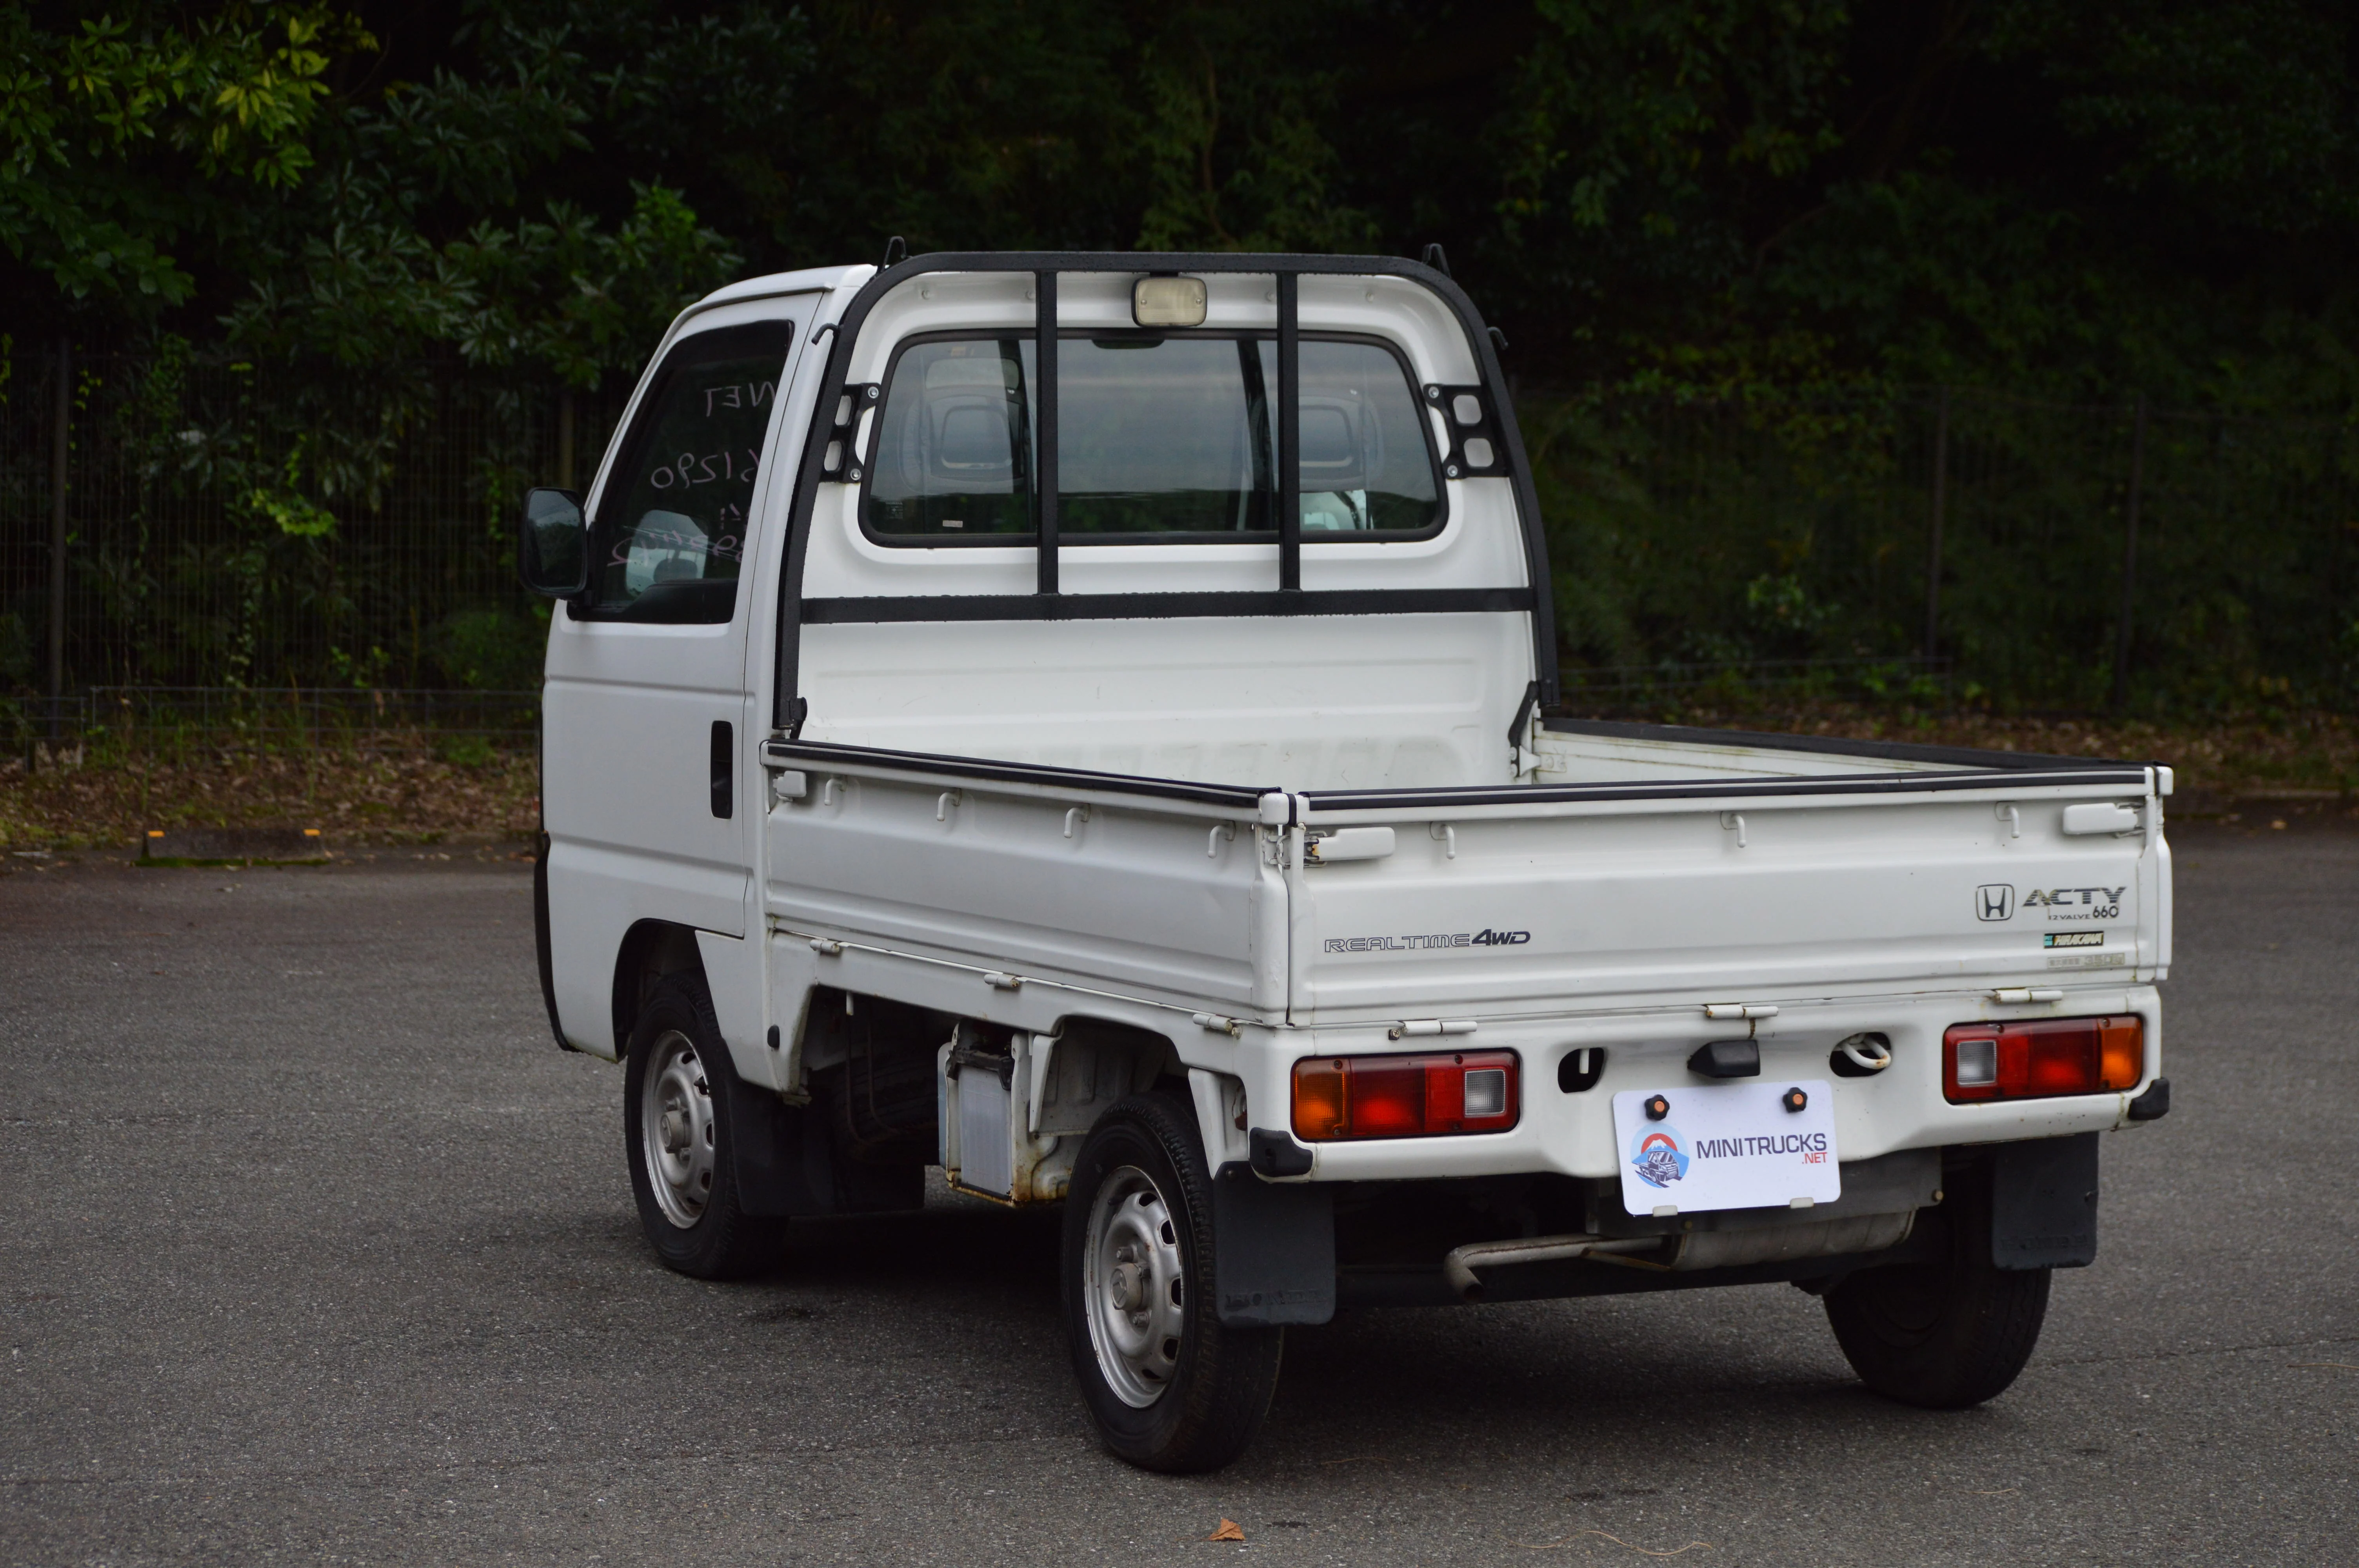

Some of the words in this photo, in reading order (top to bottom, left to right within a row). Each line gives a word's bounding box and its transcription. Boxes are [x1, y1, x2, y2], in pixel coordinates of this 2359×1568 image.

[2022, 886, 2127, 907] ACTY
[2093, 906, 2119, 918] 660
[1324, 933, 1470, 953] REALTIME
[1472, 929, 1531, 946] 4WD
[1696, 1133, 1827, 1159] MINITRUCKS
[1802, 1152, 1828, 1165] .NET
